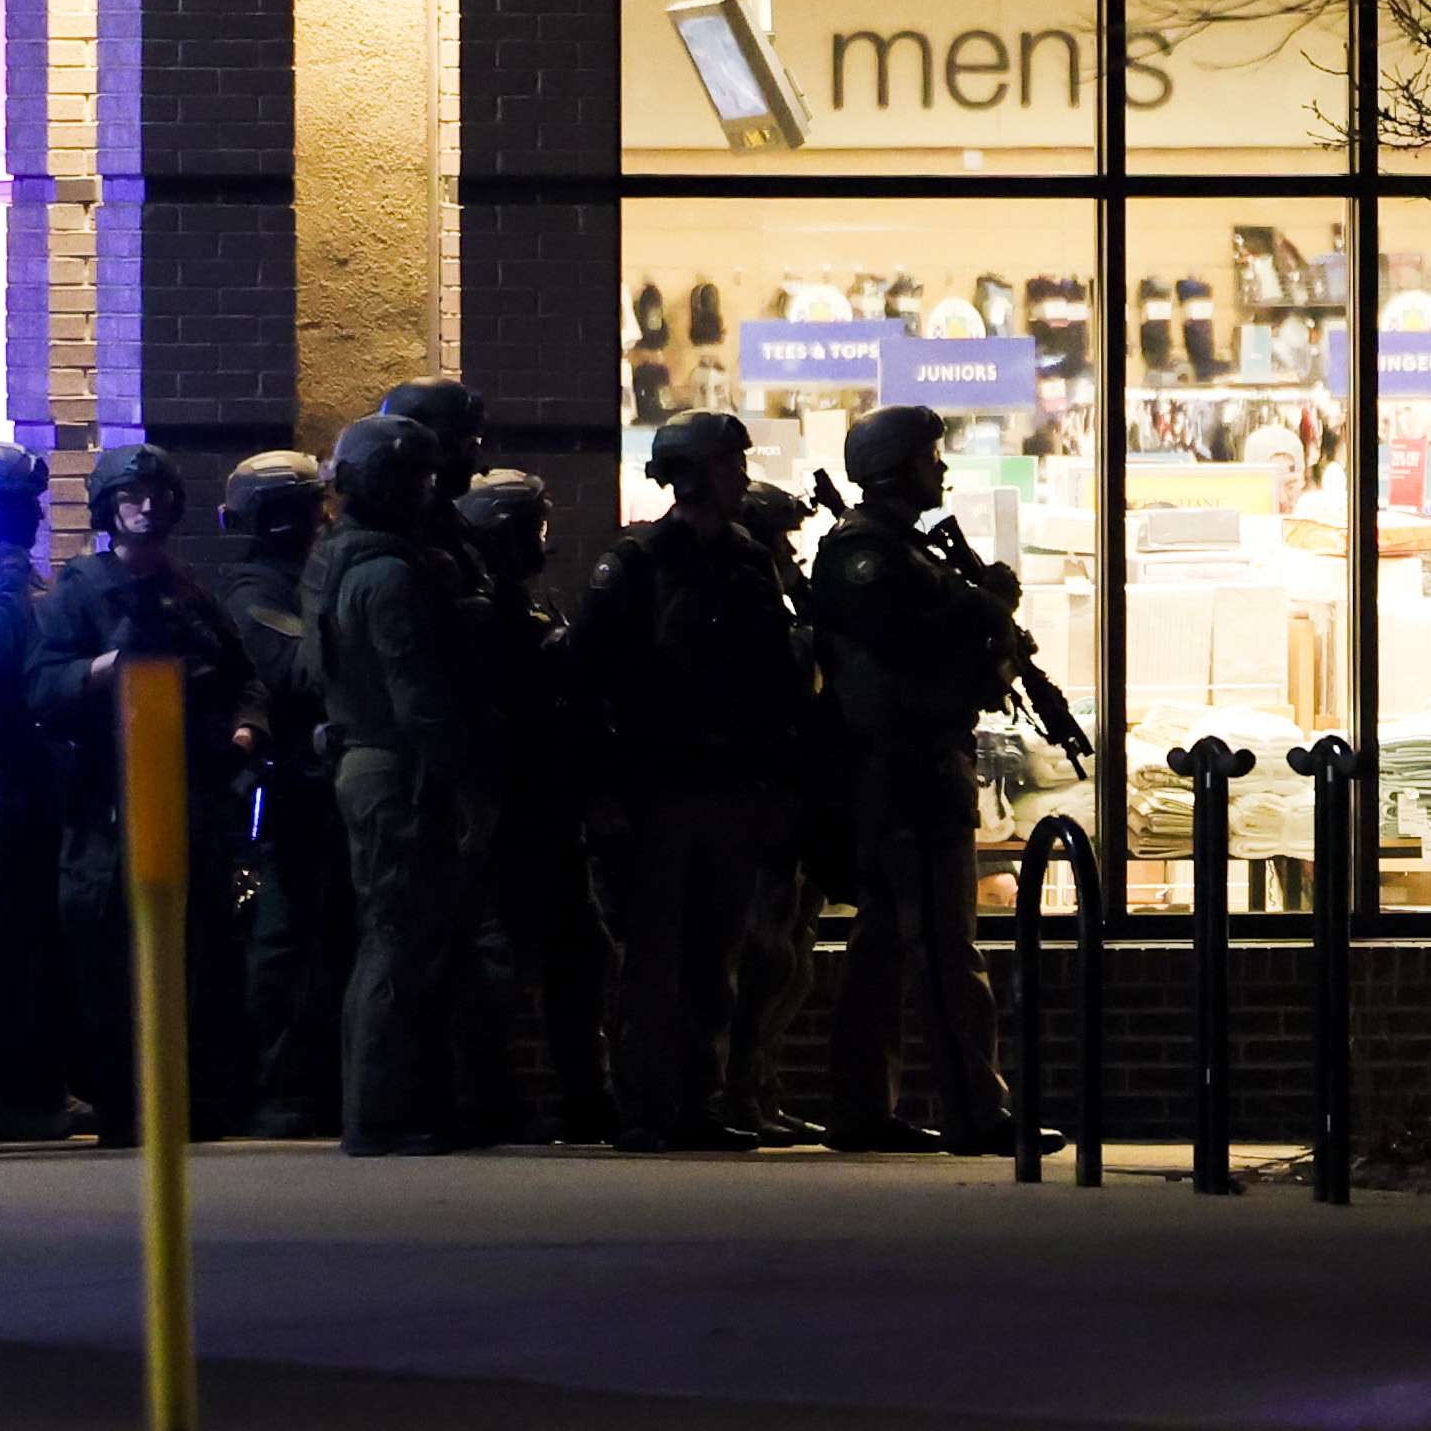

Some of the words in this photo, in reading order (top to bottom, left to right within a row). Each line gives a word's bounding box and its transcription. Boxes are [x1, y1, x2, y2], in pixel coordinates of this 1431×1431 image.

[831, 29, 1175, 111] mens
[762, 342, 808, 361] TEES
[811, 343, 827, 361] &
[832, 342, 880, 361] TOPS
[916, 363, 998, 383] JUNIORS
